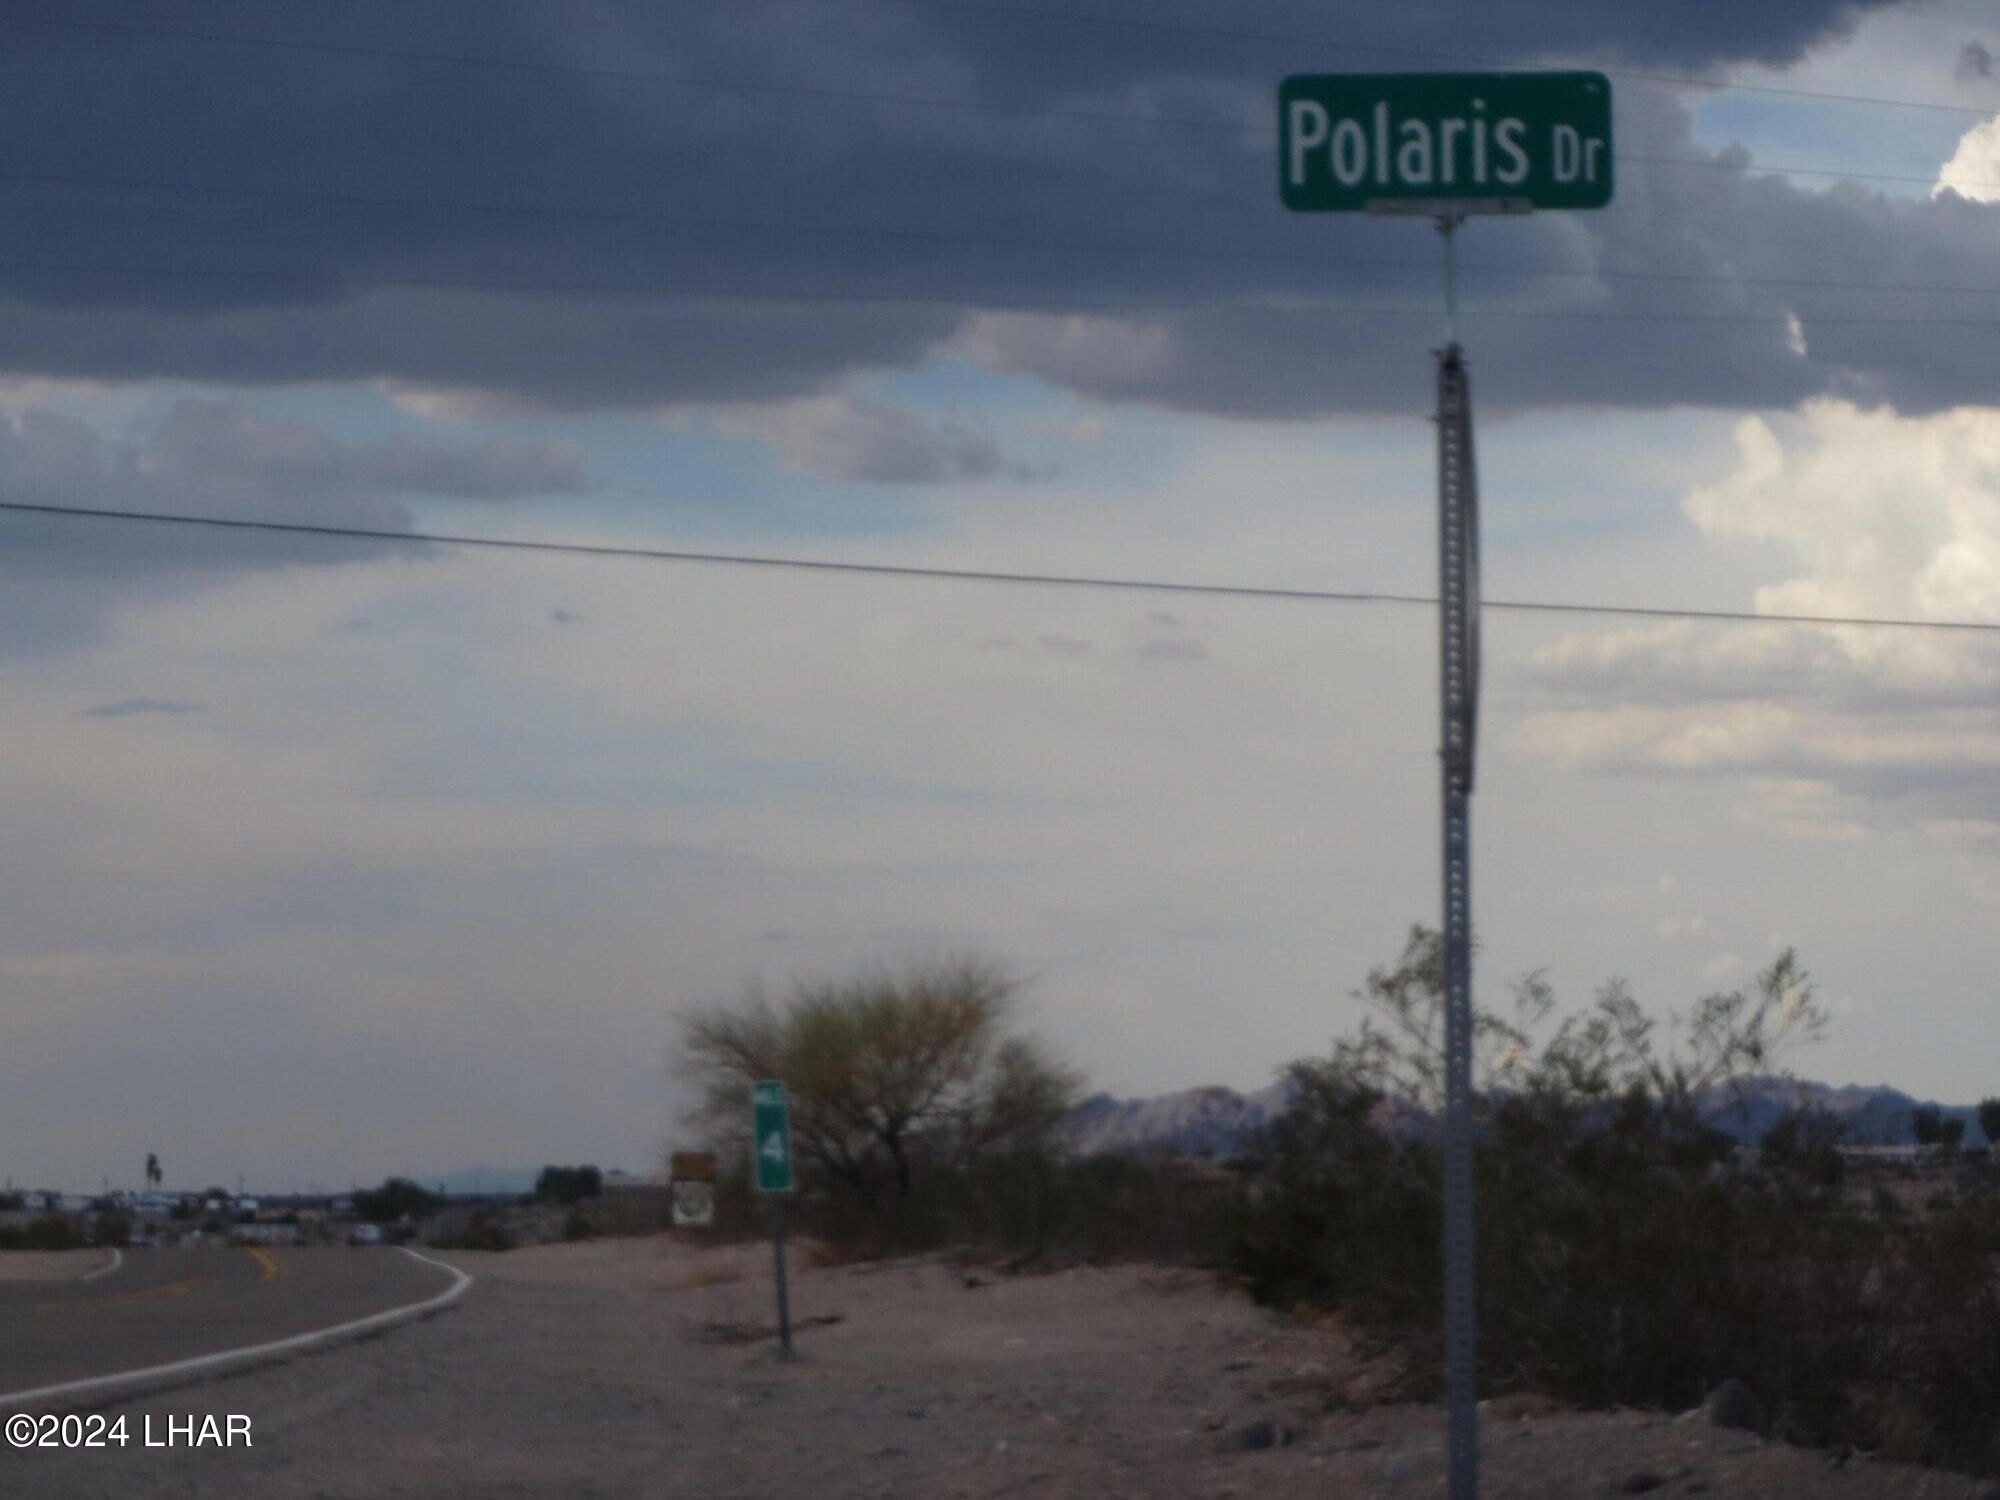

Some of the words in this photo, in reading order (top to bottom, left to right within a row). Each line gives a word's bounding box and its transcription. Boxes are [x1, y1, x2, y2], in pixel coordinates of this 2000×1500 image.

[1290, 98, 1530, 185] Polaris
[1553, 125, 1604, 182] Dr
[763, 1130, 784, 1161] 4
